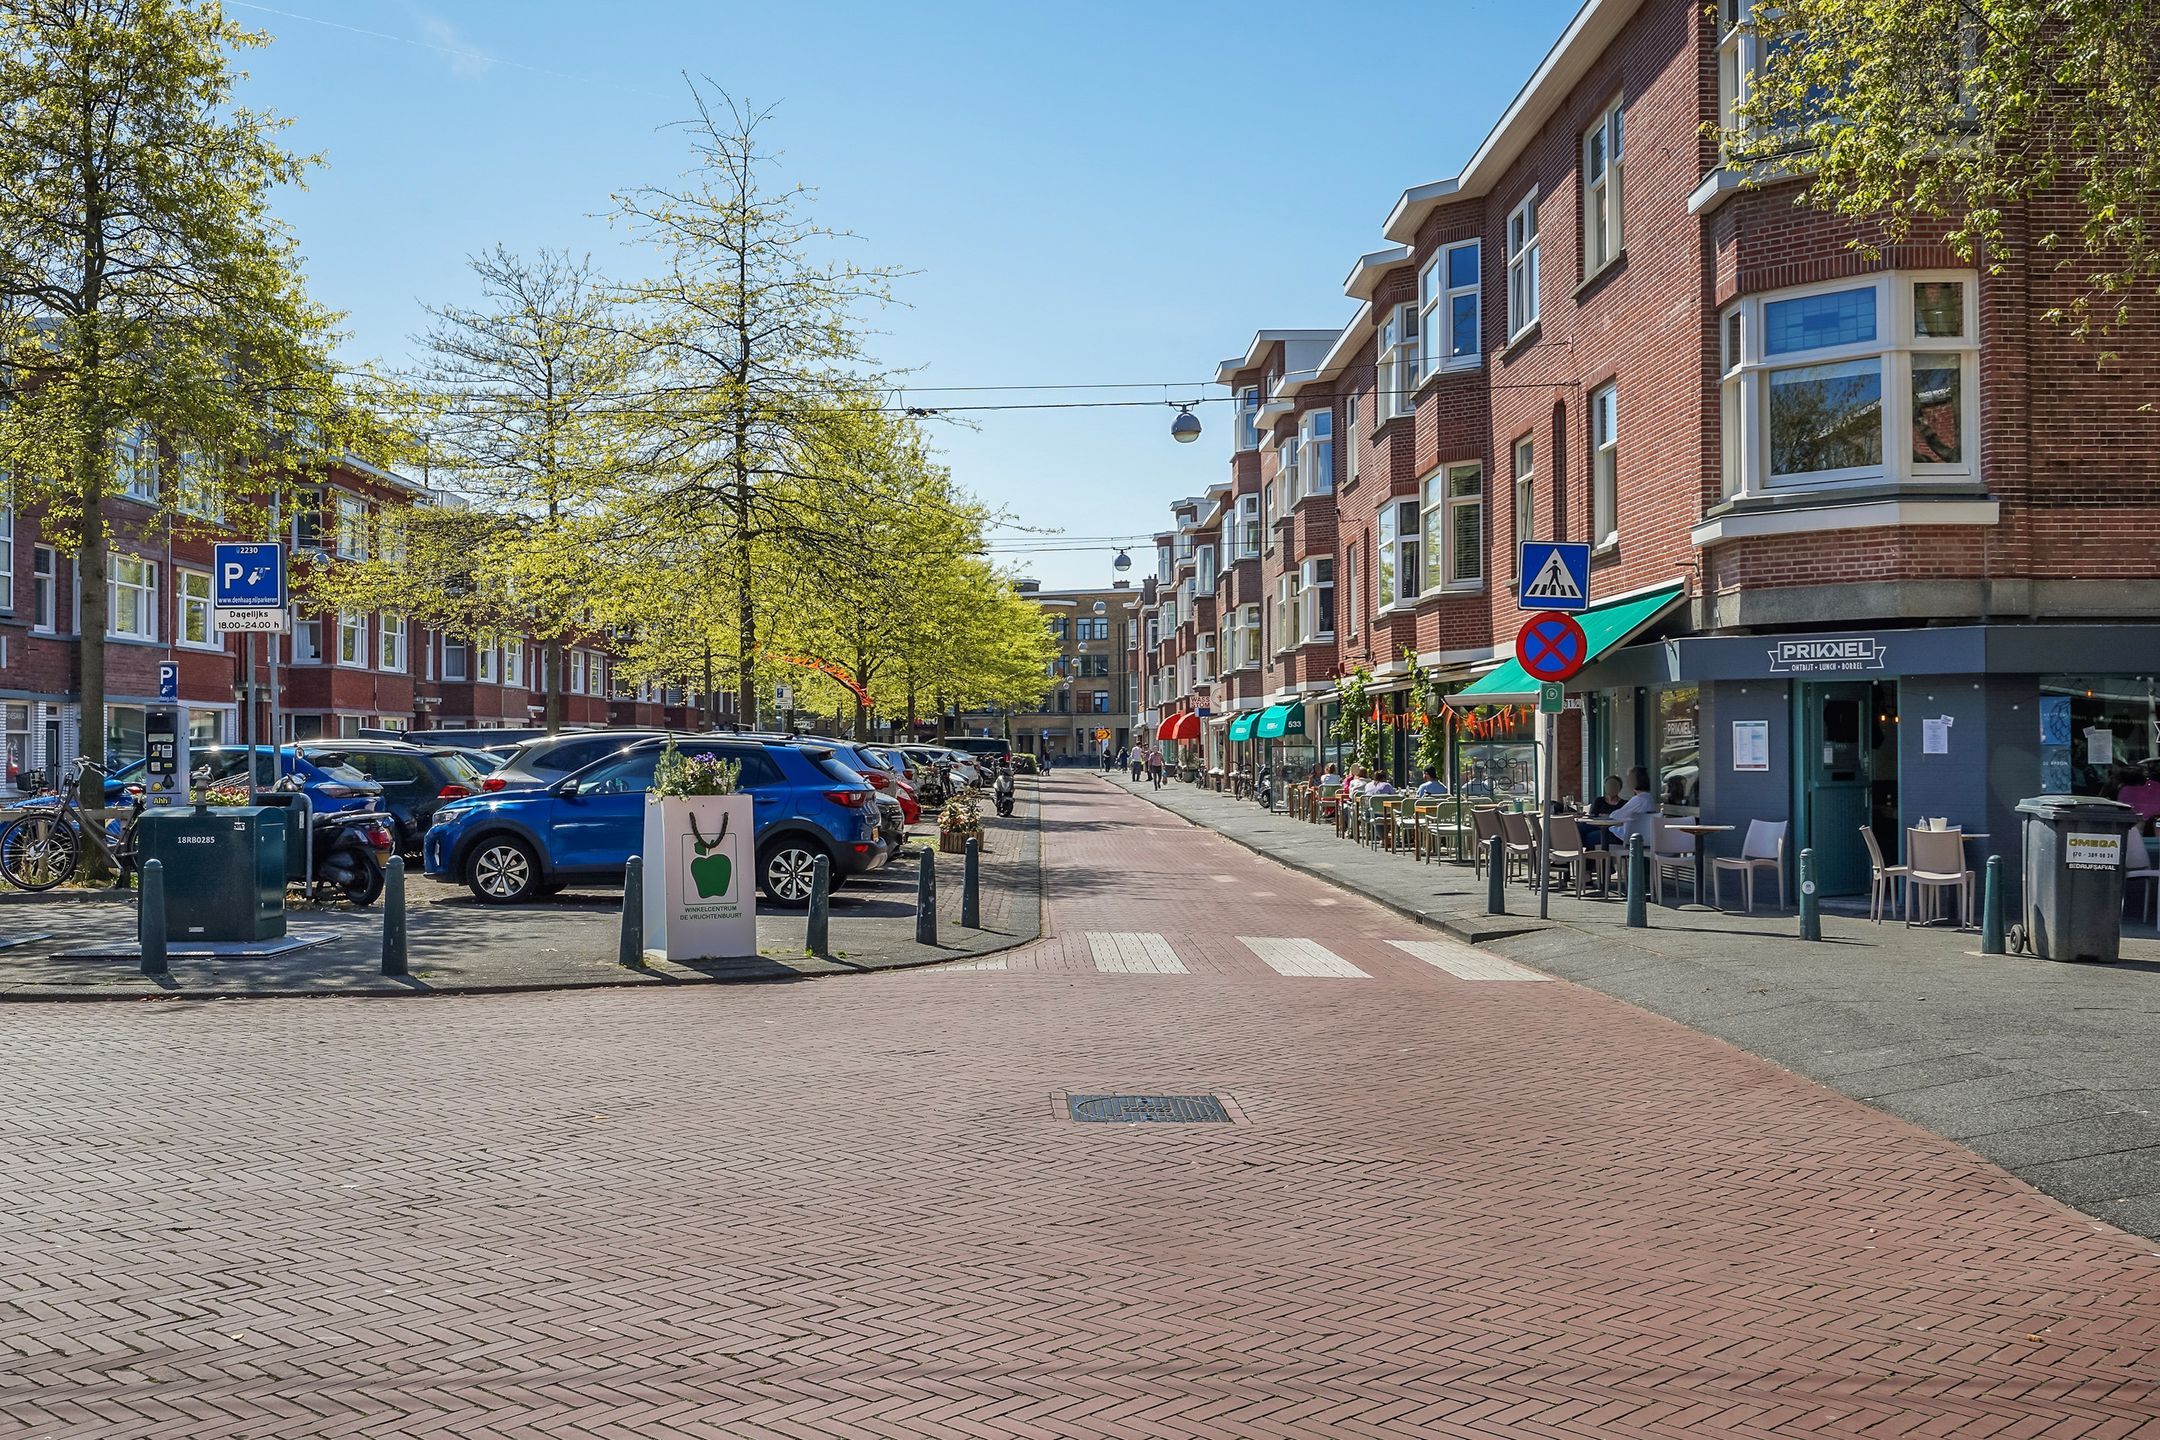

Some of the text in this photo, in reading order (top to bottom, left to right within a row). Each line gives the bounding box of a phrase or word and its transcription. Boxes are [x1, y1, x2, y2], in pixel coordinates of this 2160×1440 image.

[224, 562, 244, 589] P
[229, 610, 269, 619] Dagelijks
[218, 621, 280, 629] 18.00-24.00 h
[1819, 662, 1837, 671] LUNCH
[1841, 661, 1863, 670] BORREL
[160, 666, 174, 685] P
[1288, 720, 1302, 728] 533
[177, 836, 216, 844] 18RB0285
[2069, 839, 2118, 848] OMEGA
[690, 912, 742, 920] VRUCHTENBUURT
